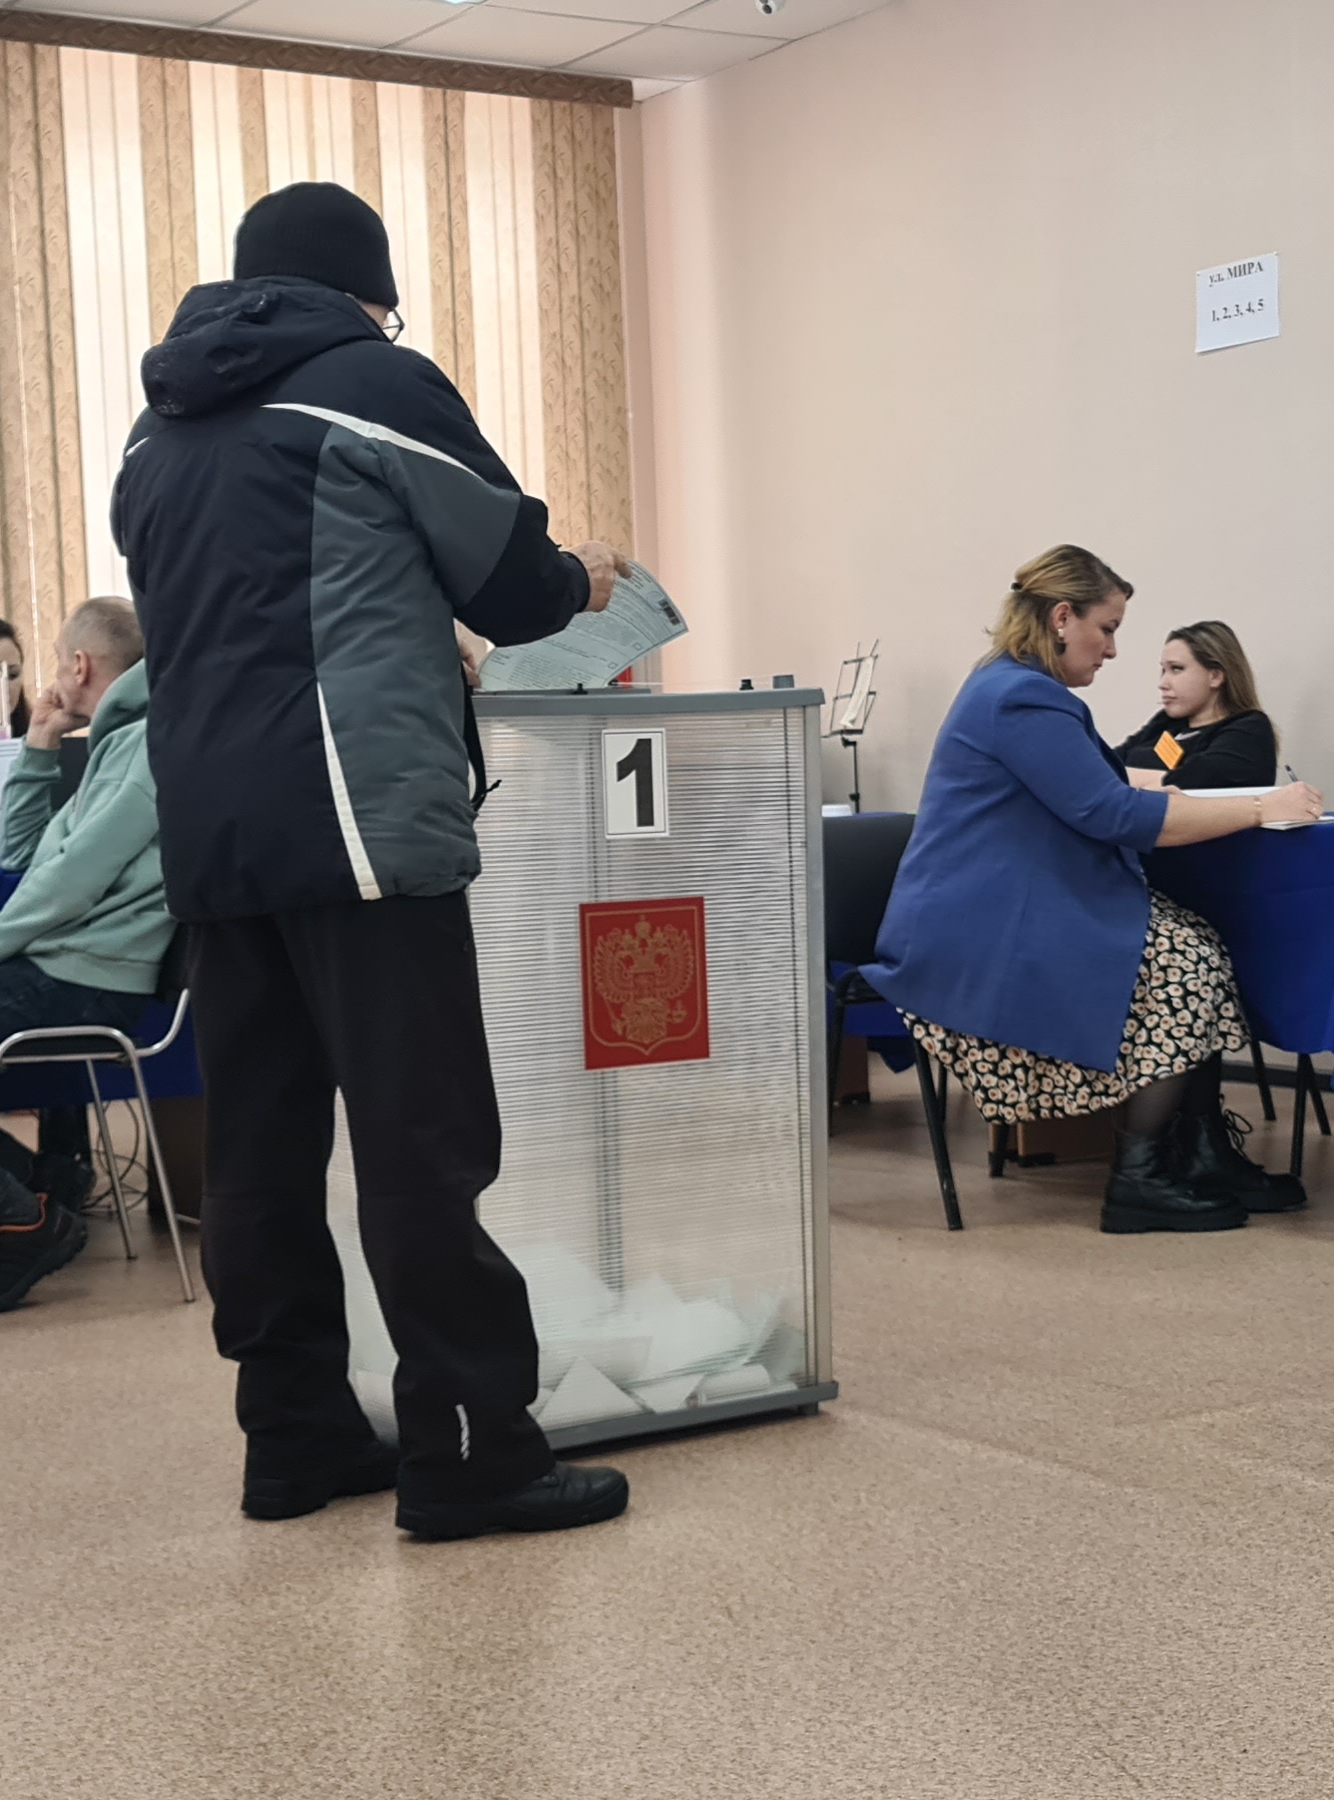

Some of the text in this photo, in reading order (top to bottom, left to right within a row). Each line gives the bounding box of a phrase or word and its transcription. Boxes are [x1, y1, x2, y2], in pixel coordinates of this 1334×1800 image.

[1209, 261, 1263, 288] ул. МИРА
[615, 738, 655, 828] 1
